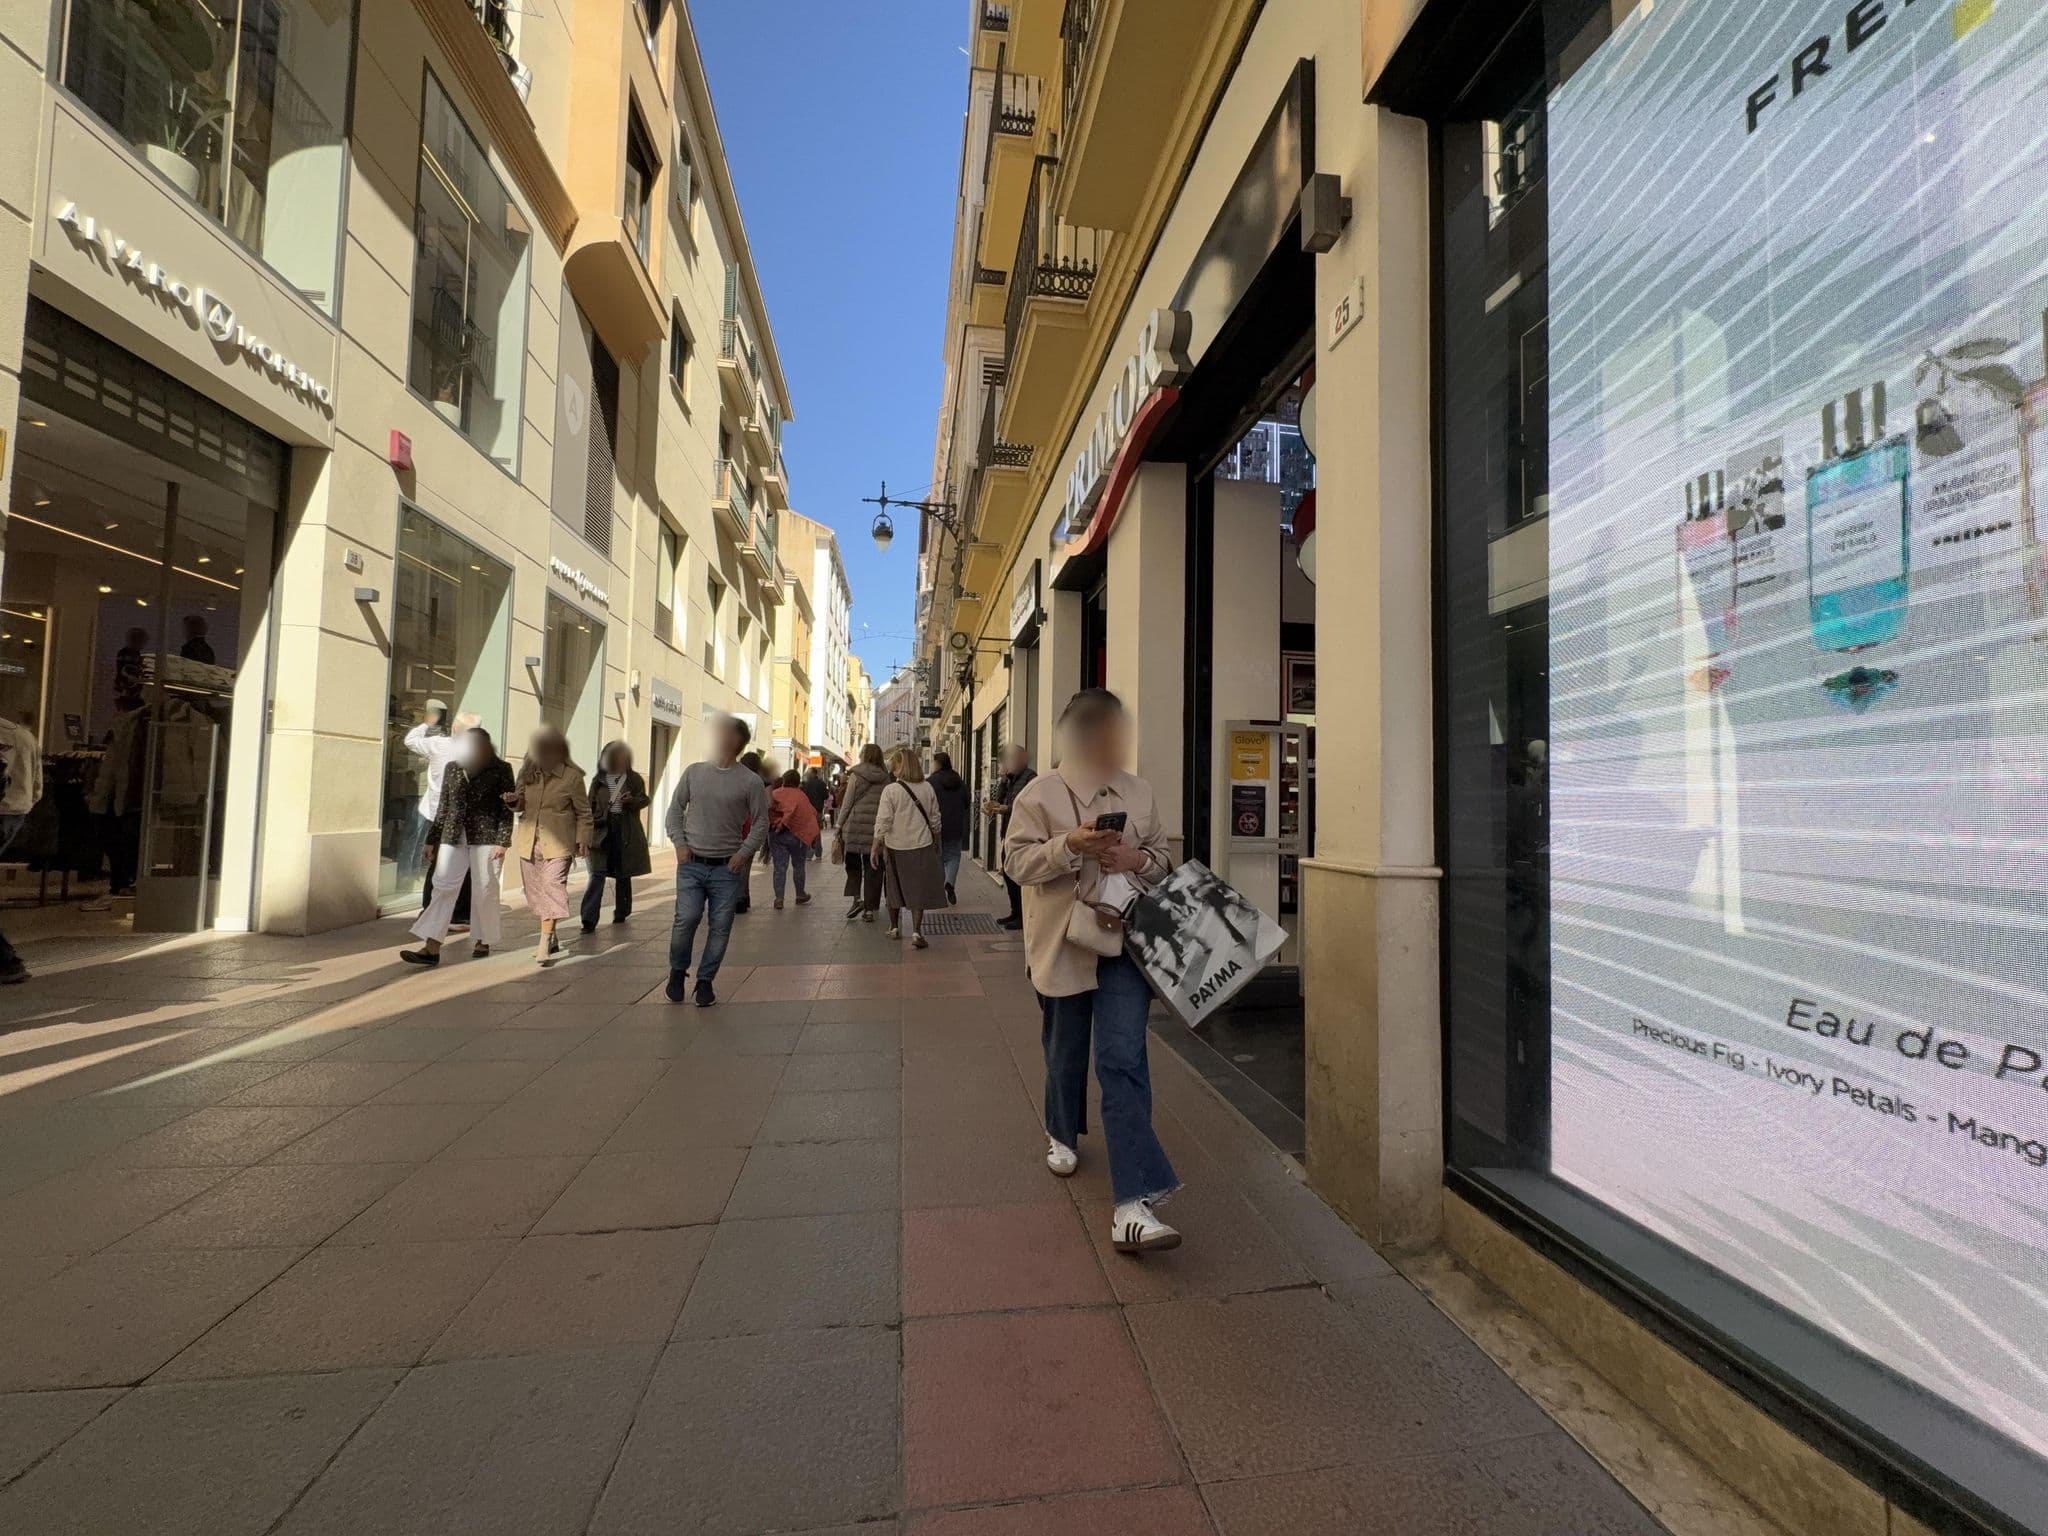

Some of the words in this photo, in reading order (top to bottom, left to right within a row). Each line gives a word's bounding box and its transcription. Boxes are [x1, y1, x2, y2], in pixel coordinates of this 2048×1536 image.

[1746, 0, 1916, 134] FRE
[56, 201, 193, 307] ALVARO
[235, 325, 332, 406] MORENO
[1334, 295, 1350, 335] 25
[1065, 308, 1184, 535] PRIMOR
[1234, 735, 1262, 746] Glovo
[1188, 959, 1243, 1010] PAYMA
[1632, 1017, 1708, 1057] Precious
[1713, 1041, 1746, 1072] Fig
[1765, 1056, 1826, 1097] Ivory
[1832, 1076, 1918, 1123] Petals
[1947, 1110, 2048, 1168] Mang
[1786, 998, 1877, 1047] Eau
[1896, 1025, 1969, 1070] de
[1995, 1043, 2048, 1094] P
